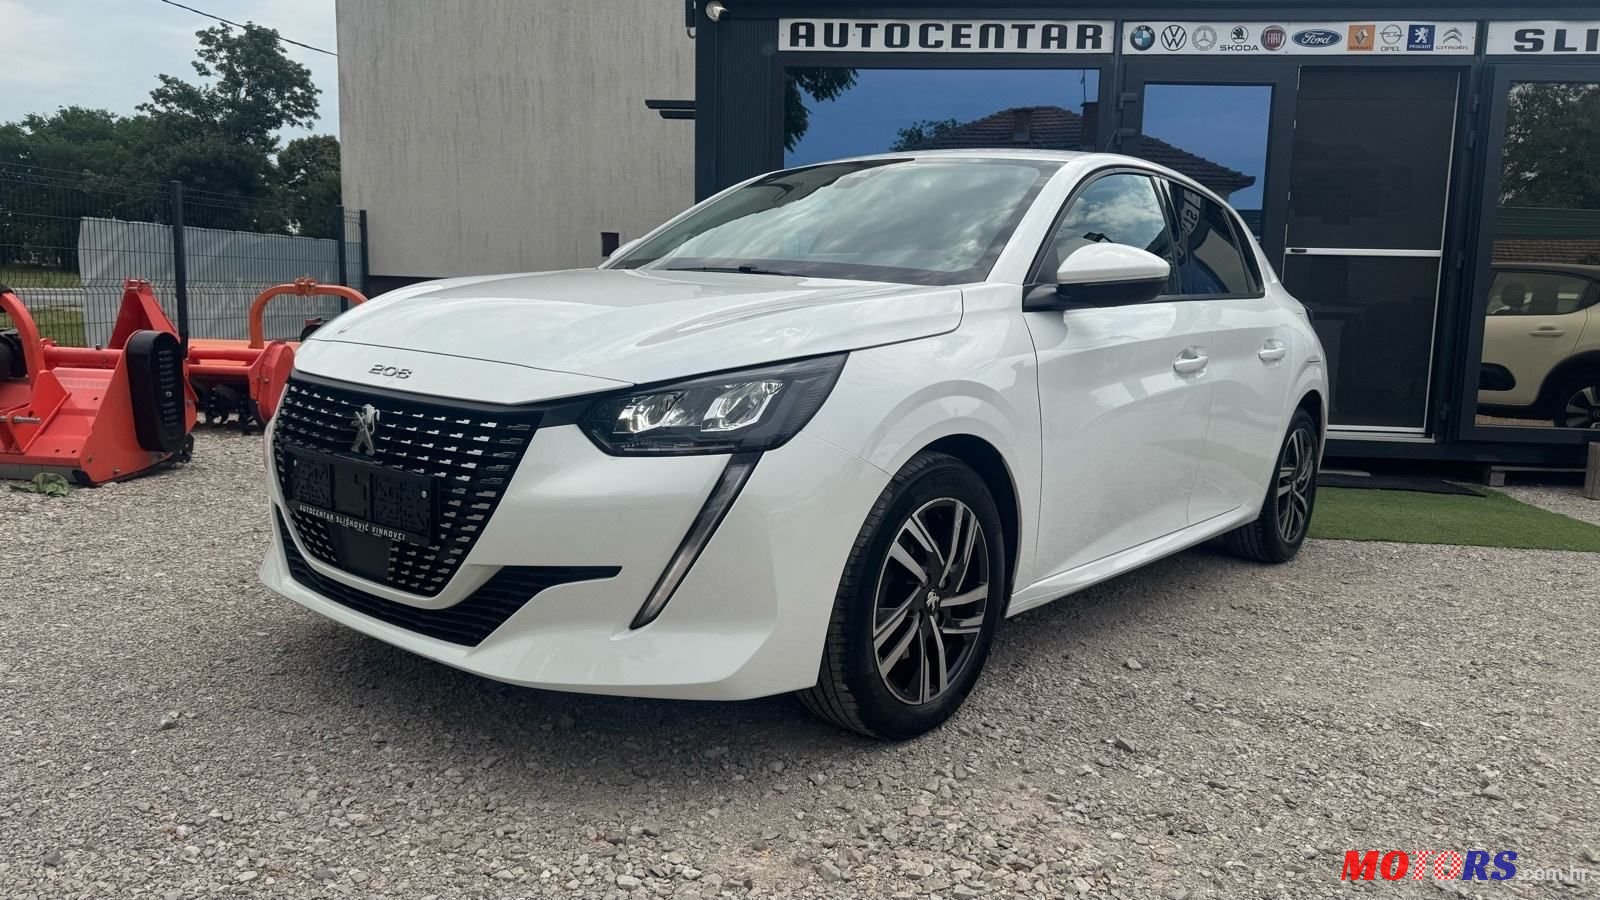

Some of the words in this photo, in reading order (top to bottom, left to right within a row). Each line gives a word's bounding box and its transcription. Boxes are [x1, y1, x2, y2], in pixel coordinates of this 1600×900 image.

[789, 22, 1103, 50] AUTOCENTAR
[1267, 33, 1281, 44] FIAT
[1301, 32, 1332, 45] Ford
[1513, 28, 1599, 52] SLI
[299, 504, 334, 521] AUTOCENTAR
[372, 526, 406, 541] VINKOVCI
